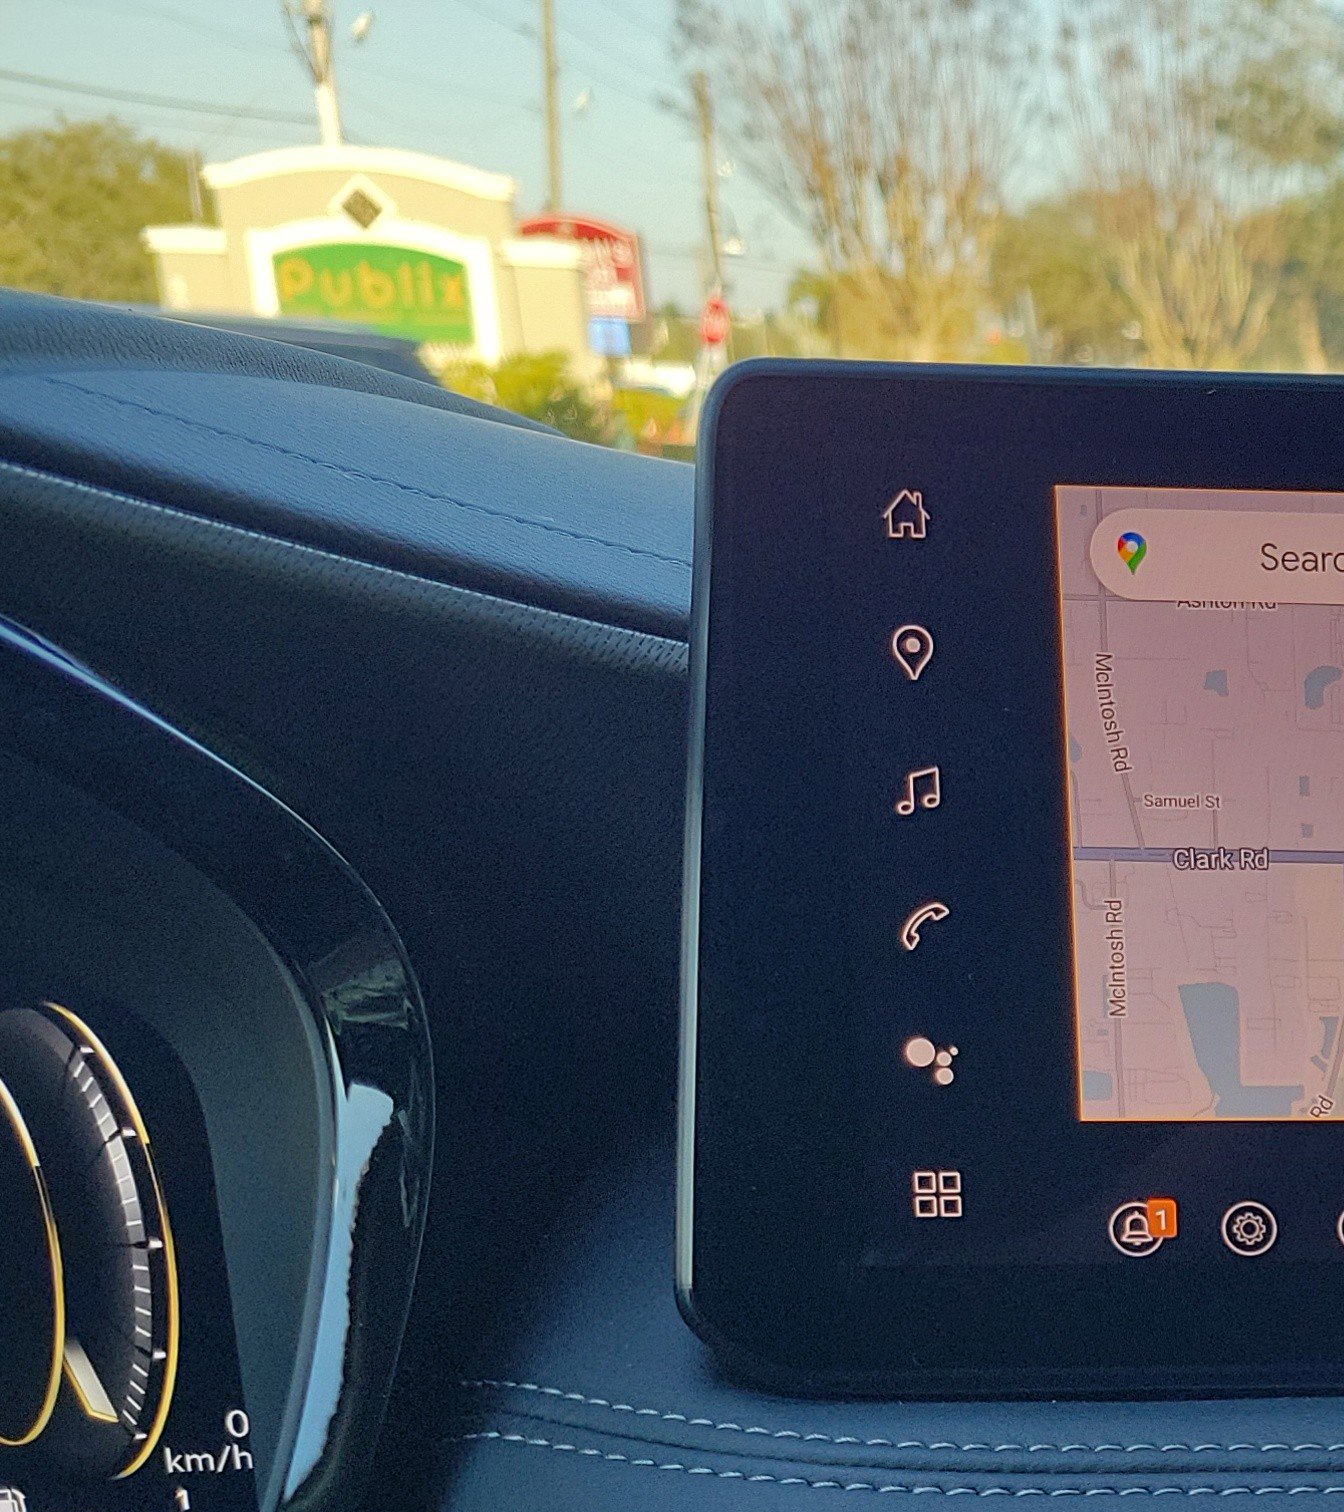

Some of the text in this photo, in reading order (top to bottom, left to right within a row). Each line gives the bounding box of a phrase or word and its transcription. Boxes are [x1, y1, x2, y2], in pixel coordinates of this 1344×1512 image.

[1095, 653, 1133, 772] McIntosh Rd
[1143, 794, 1221, 808] Samuel St
[1173, 847, 1270, 871] Clark Rd
[1103, 900, 1127, 1017] McIntosh Rd
[1310, 1094, 1334, 1118] Rd
[1155, 1210, 1166, 1230] 1
[224, 1408, 249, 1438] 0
[164, 1442, 254, 1474] km/h
